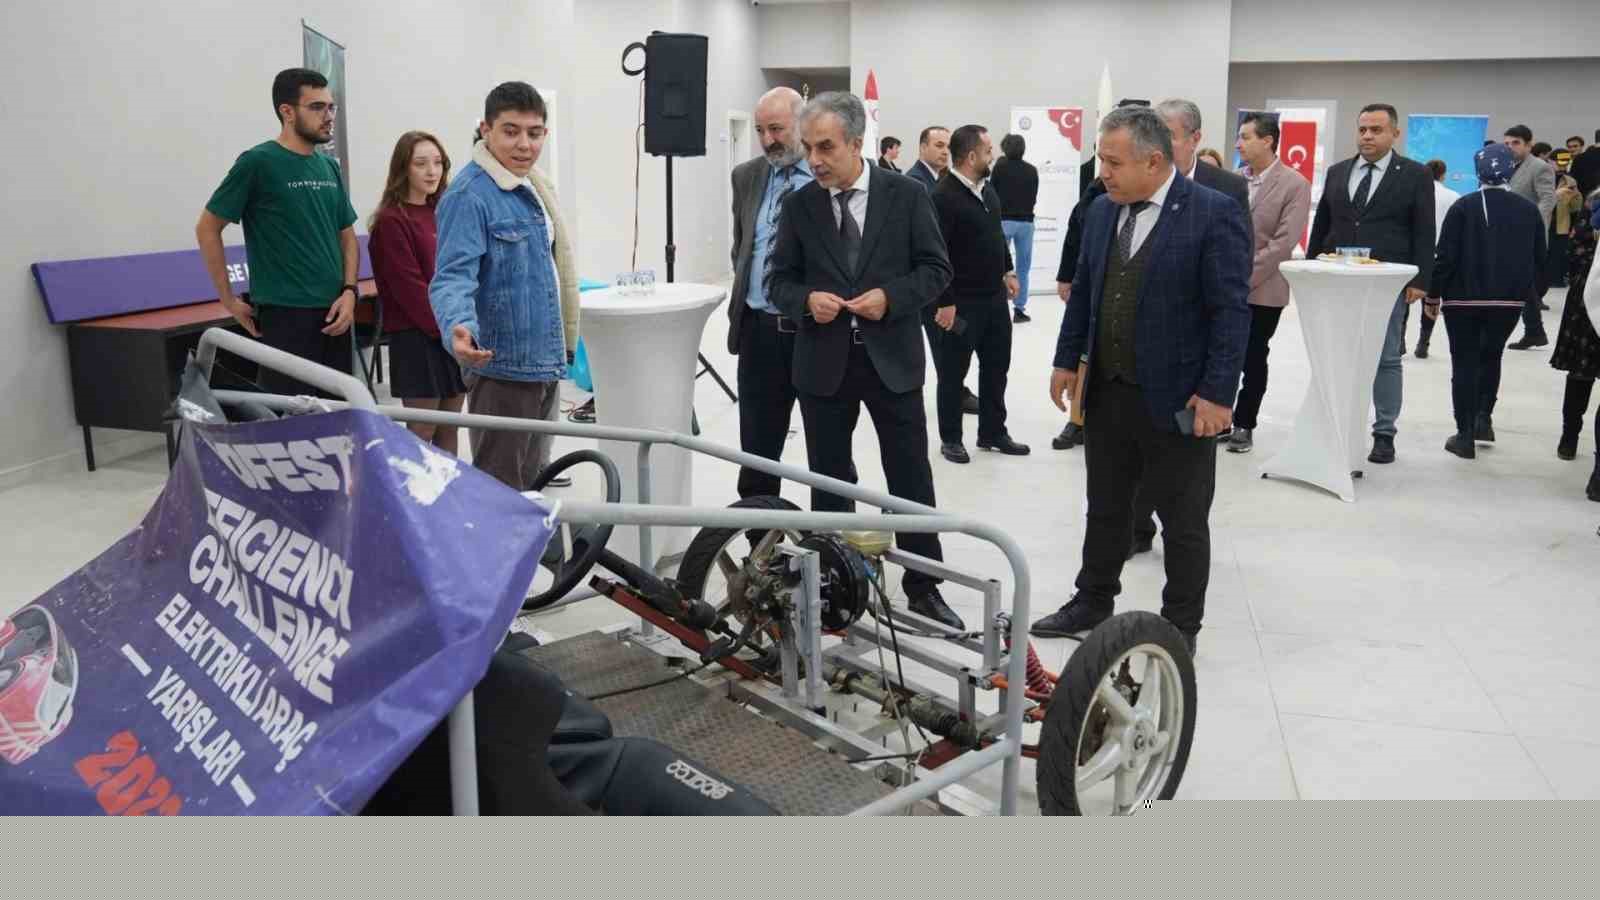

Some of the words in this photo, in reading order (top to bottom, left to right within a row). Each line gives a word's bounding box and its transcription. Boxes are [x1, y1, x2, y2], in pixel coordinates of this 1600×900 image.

[155, 592, 276, 717] ELEKTRİKLİ
[252, 686, 318, 773] ARAÇ
[189, 534, 350, 704] CHALLENGE
[146, 665, 246, 787] YARIŞLARI
